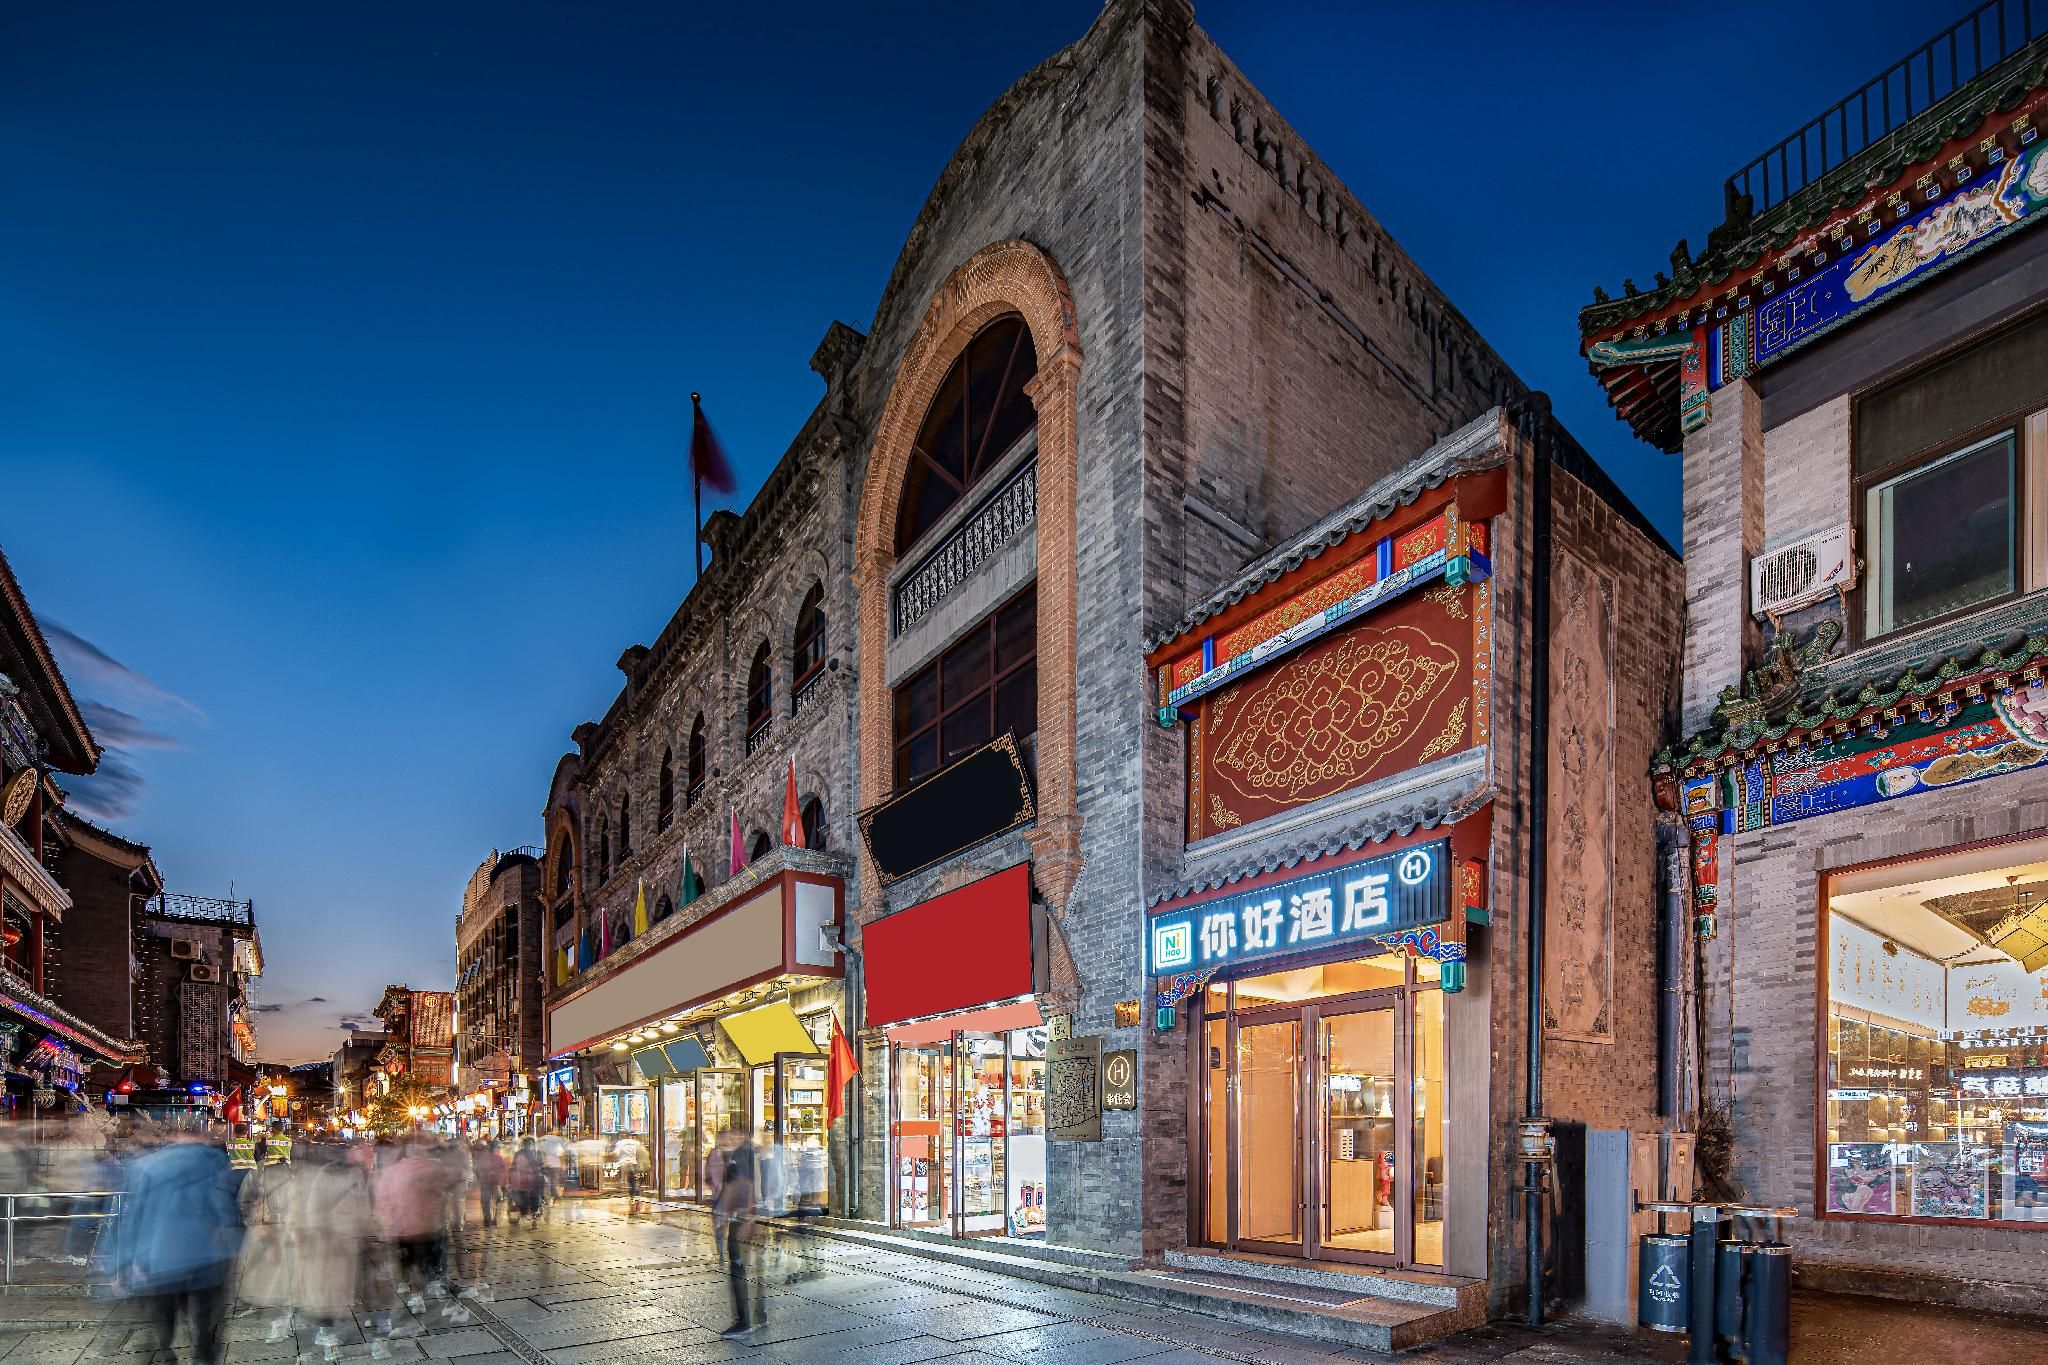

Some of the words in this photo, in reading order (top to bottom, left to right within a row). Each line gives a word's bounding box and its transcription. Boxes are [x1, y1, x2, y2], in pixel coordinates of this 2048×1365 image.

[1200, 874, 1389, 958] 你好酒店
[1165, 933, 1180, 950] Ni
[1106, 1092, 1131, 1106] 华住会
